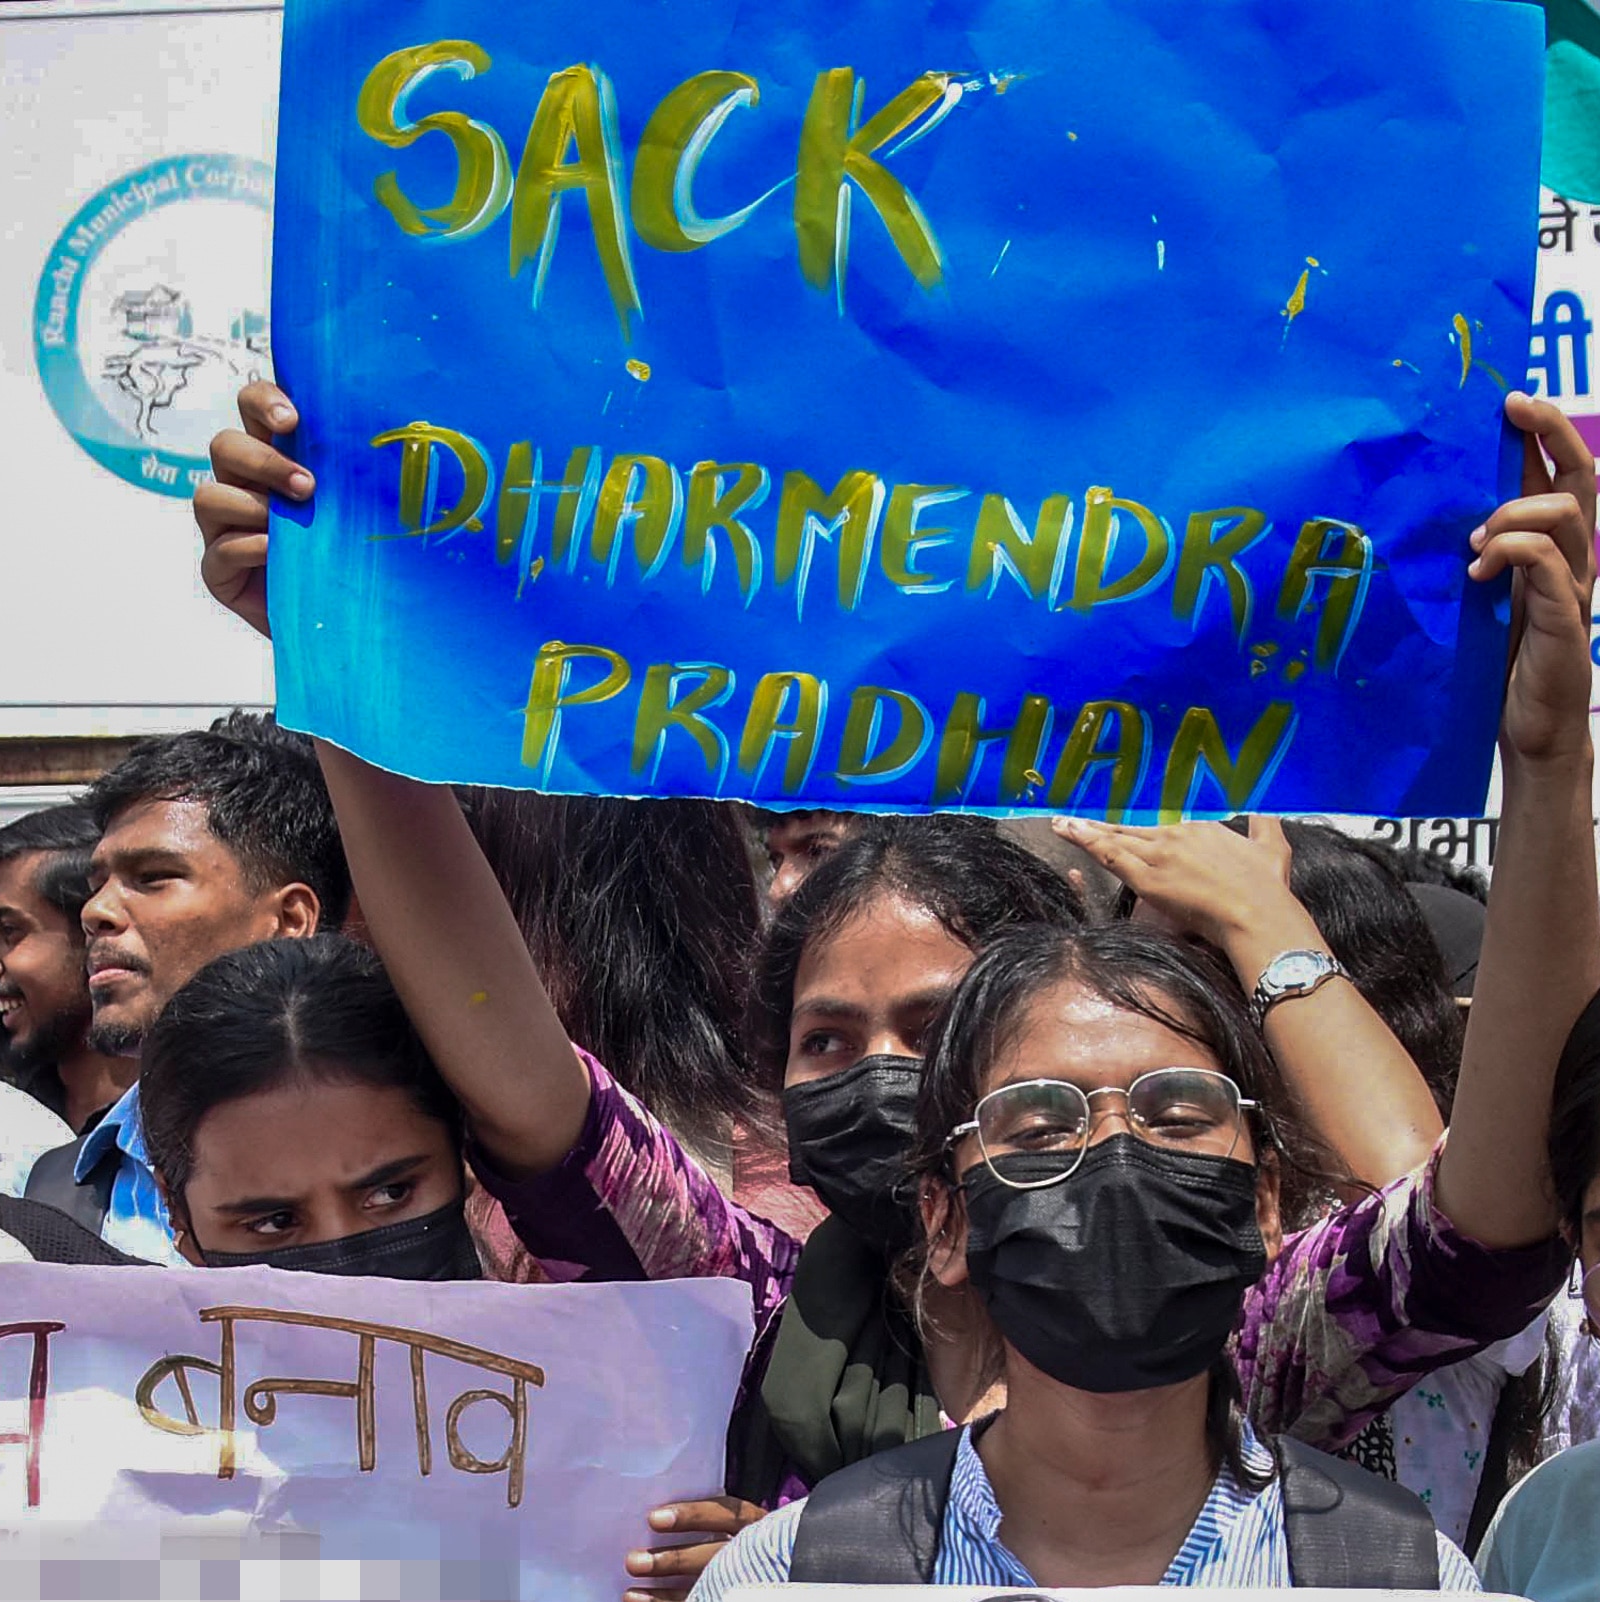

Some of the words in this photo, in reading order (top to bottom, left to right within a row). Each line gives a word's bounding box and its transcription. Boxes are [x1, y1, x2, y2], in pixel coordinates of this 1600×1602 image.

[356, 38, 962, 332] SACK
[367, 418, 1388, 676] DHARMENDRA
[517, 638, 1303, 824] PRADHAN
